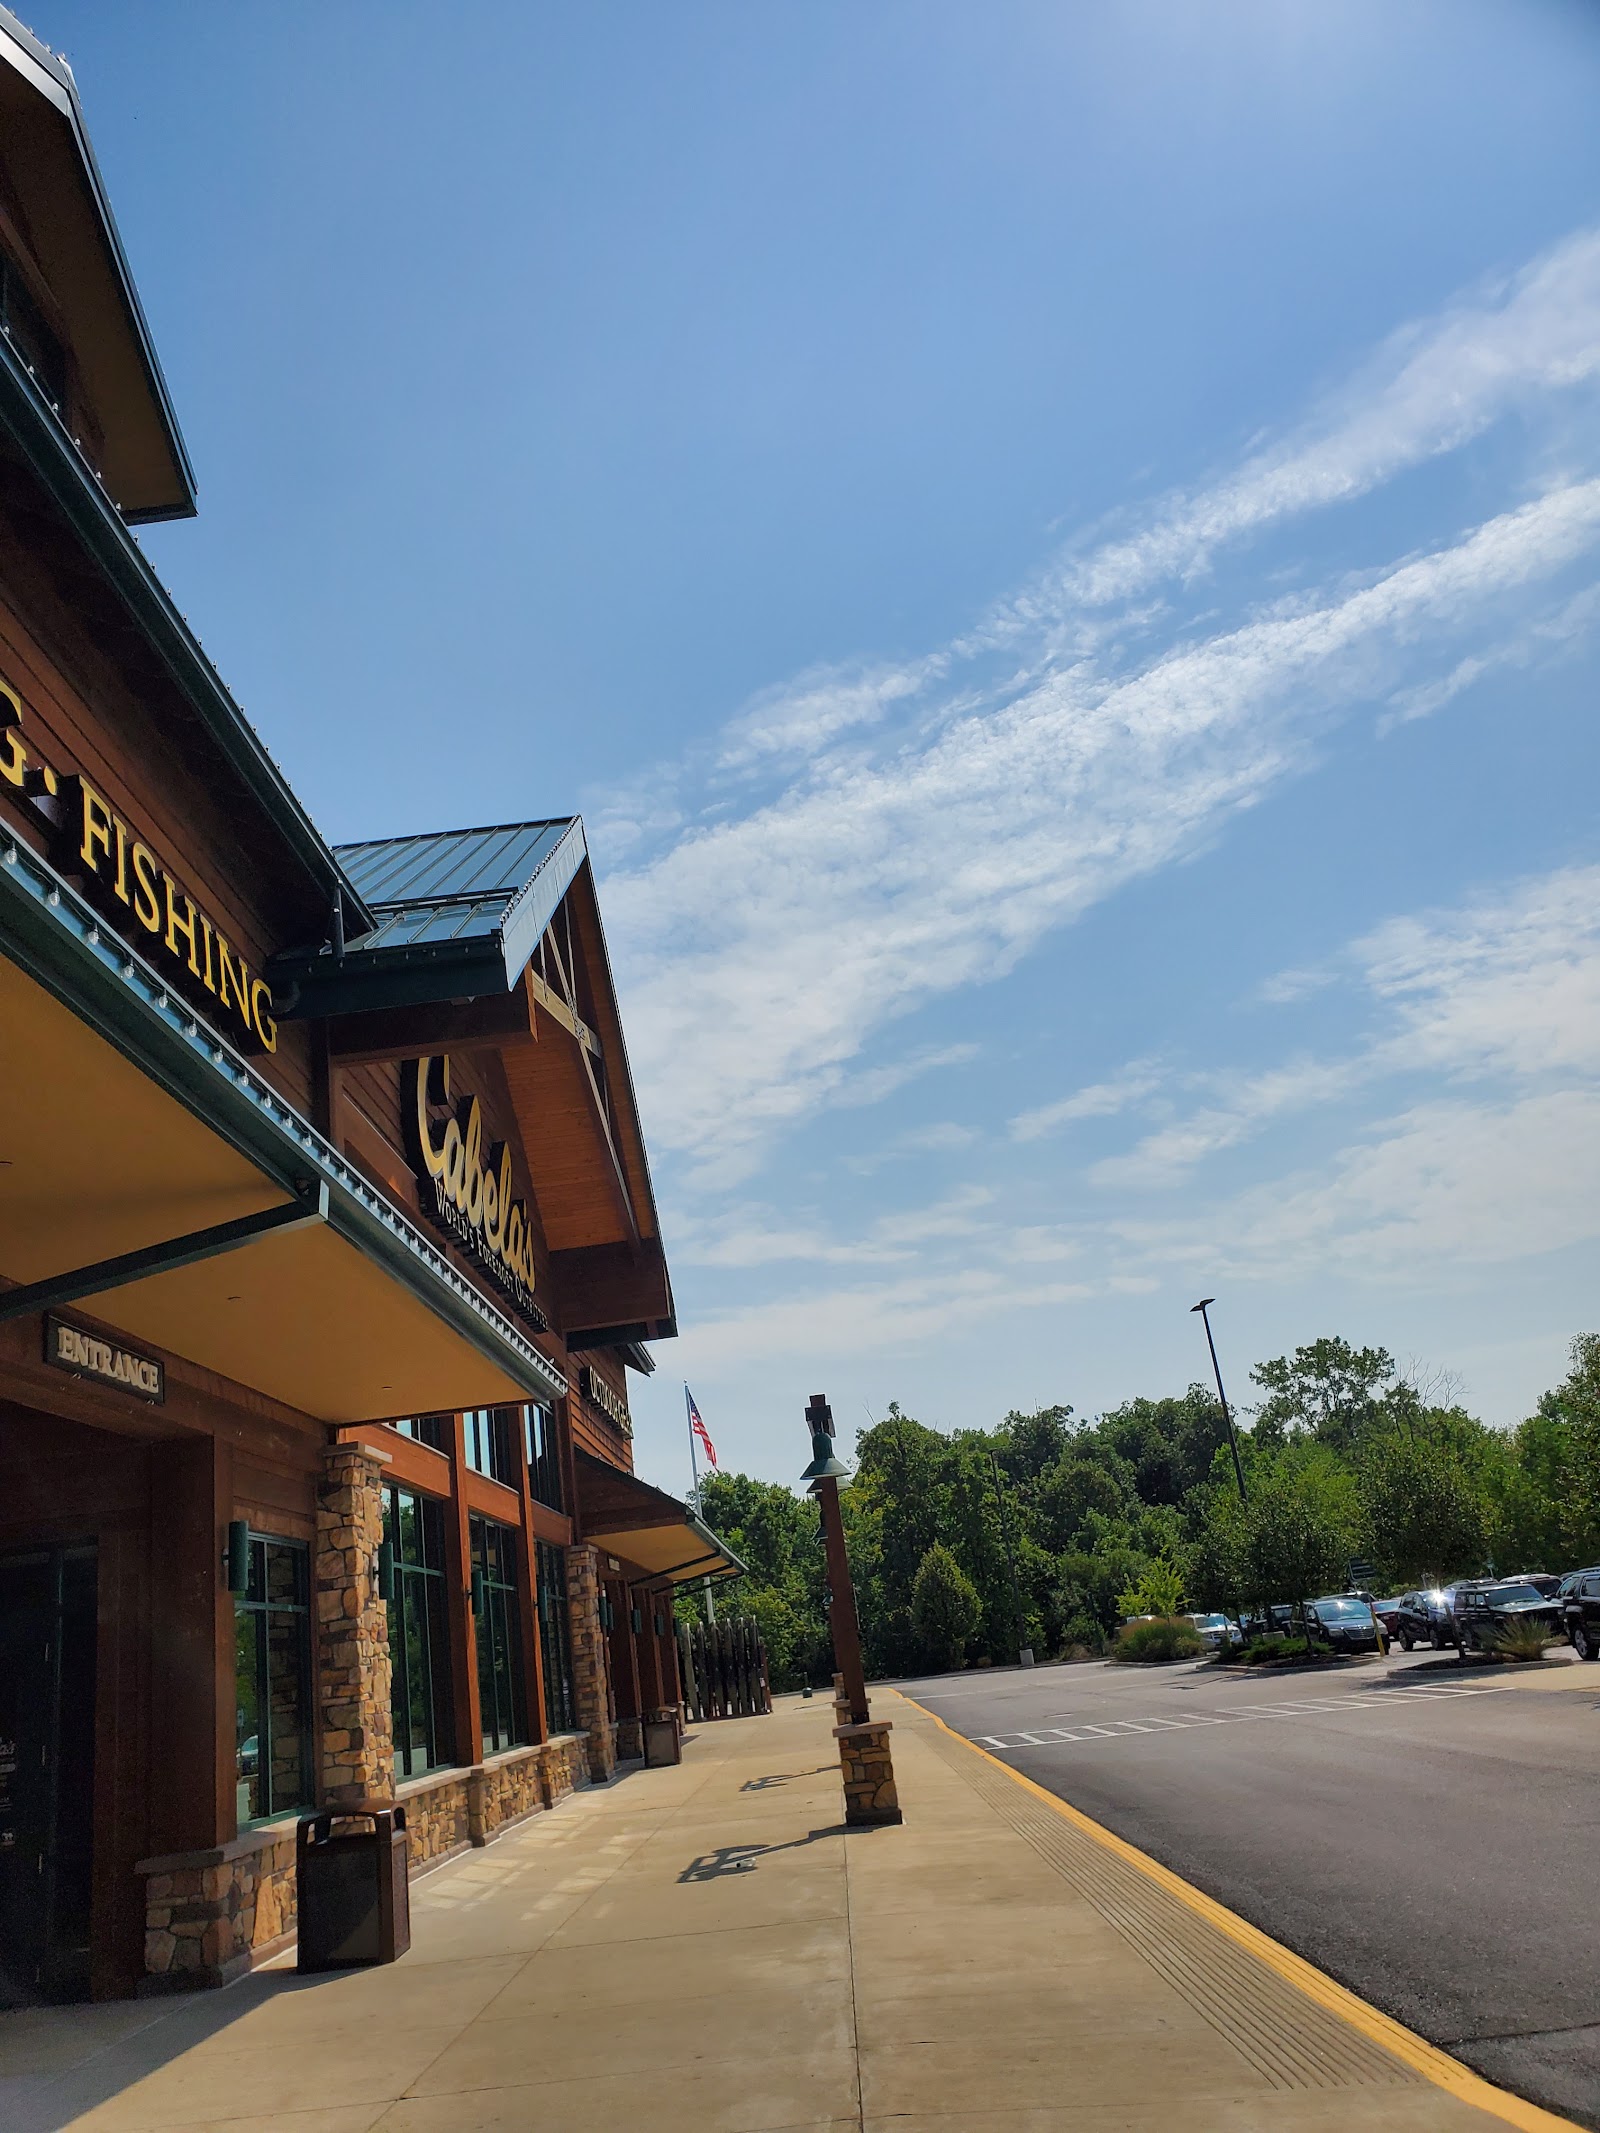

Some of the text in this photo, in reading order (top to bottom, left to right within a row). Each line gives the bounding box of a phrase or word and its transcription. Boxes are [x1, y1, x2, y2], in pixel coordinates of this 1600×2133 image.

[79, 776, 278, 1054] FISHING
[416, 1054, 535, 1293] Cabela's
[57, 1326, 159, 1394] ENTRANCE
